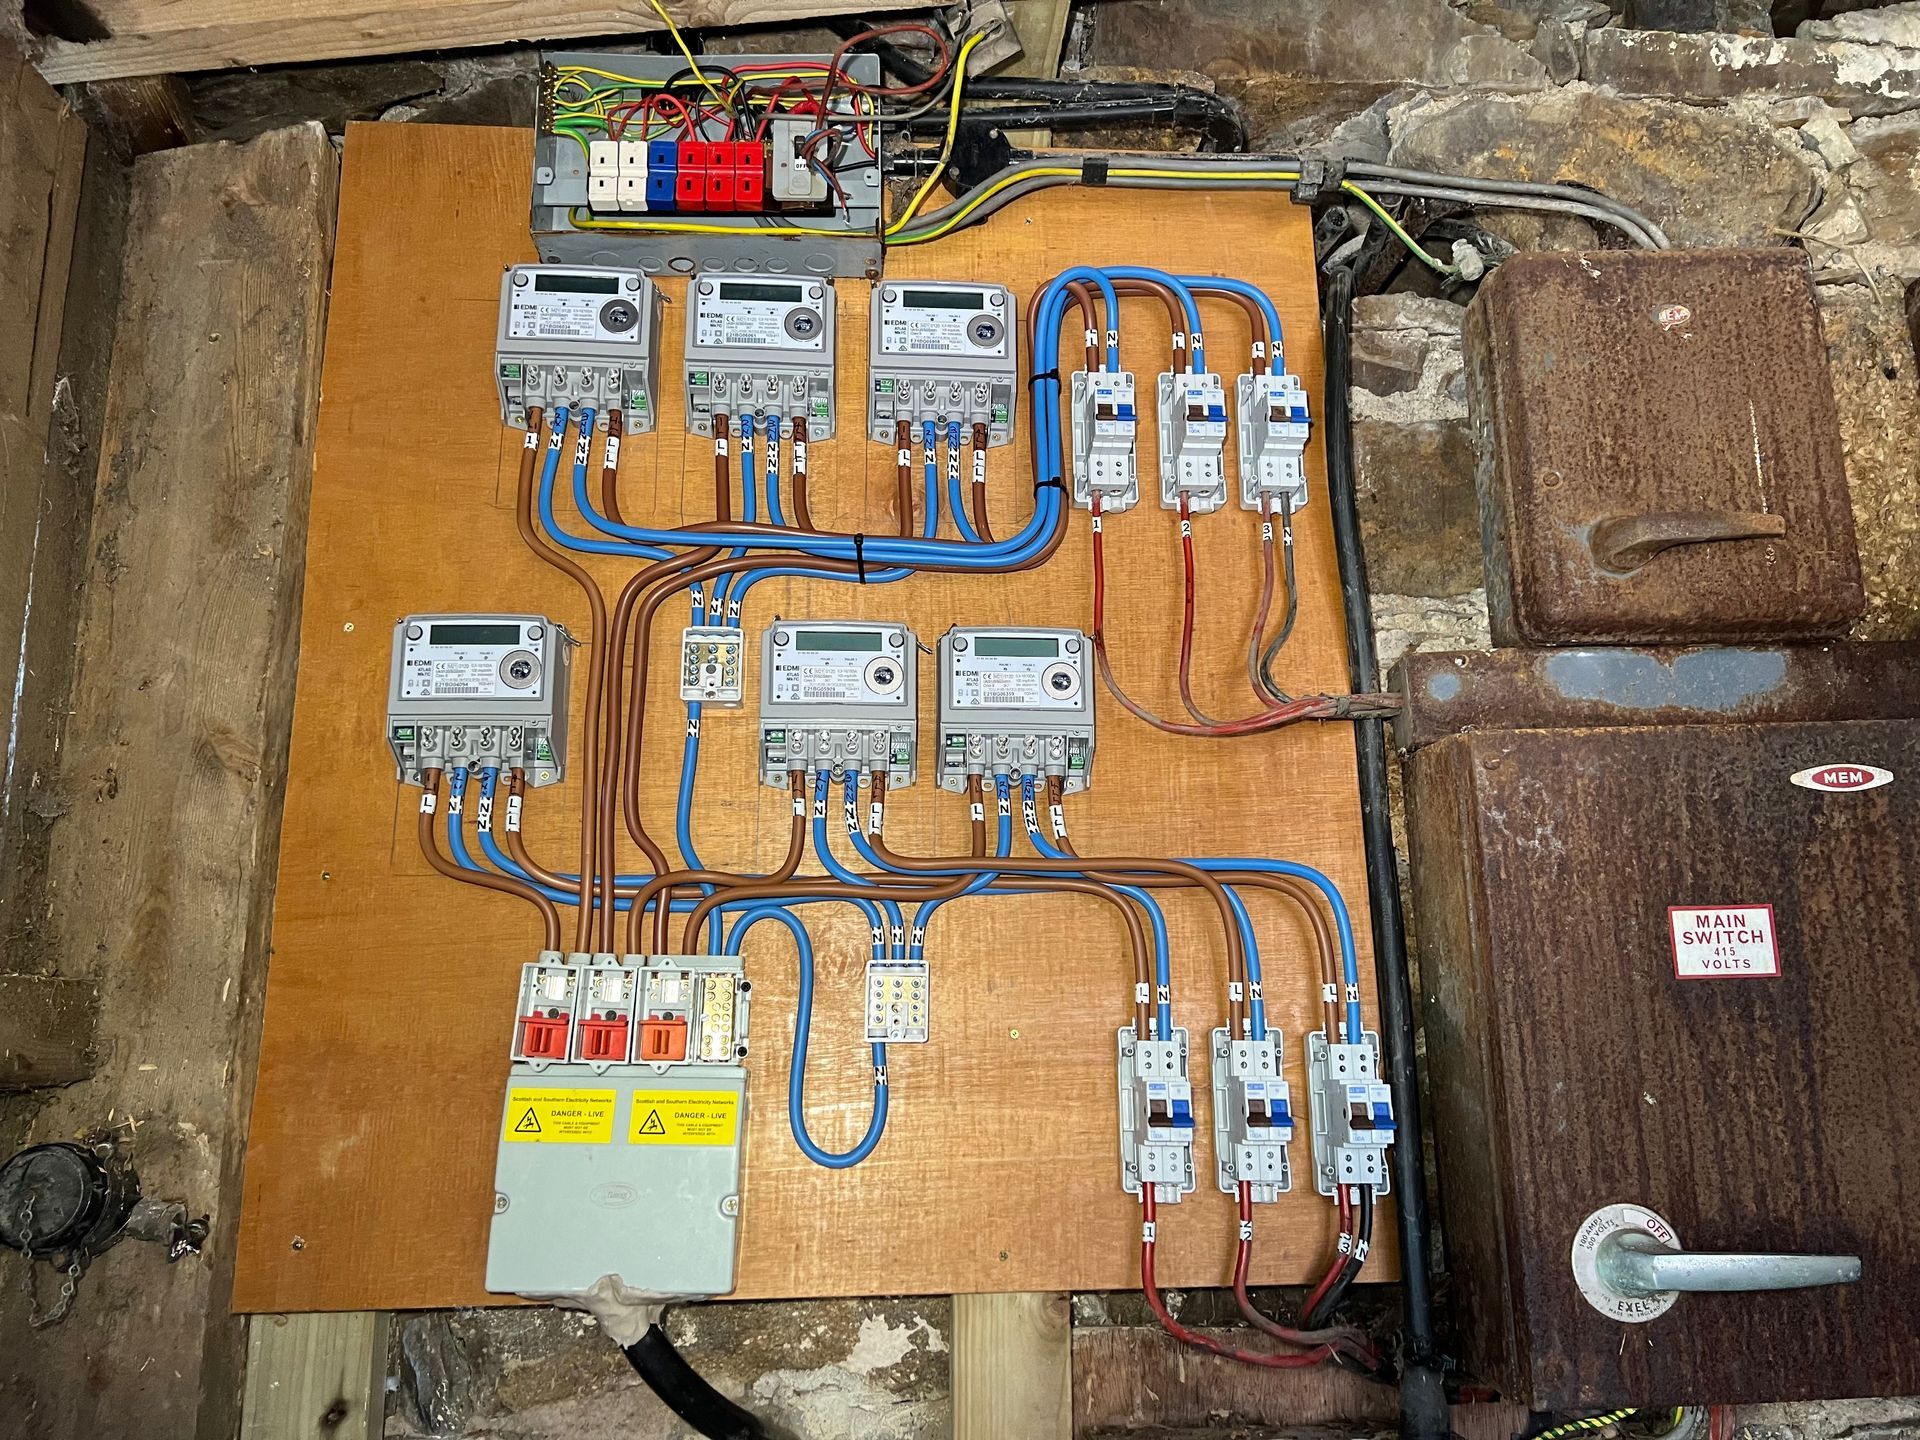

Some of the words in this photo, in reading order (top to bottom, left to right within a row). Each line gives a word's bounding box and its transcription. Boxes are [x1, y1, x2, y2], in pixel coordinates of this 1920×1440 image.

[1193, 335, 1200, 344] N
[1256, 344, 1263, 352] L
[1273, 343, 1280, 351] N
[550, 439, 558, 447] N
[578, 442, 586, 450] N
[608, 439, 615, 447] L
[717, 441, 725, 449] L
[742, 442, 749, 451] N
[768, 443, 776, 452] N
[576, 455, 584, 464] N
[606, 454, 614, 462] L
[904, 451, 910, 460] L
[926, 454, 934, 463] N
[950, 454, 957, 462] N
[976, 452, 983, 460] L
[768, 459, 776, 468] N
[950, 465, 958, 474] N
[976, 468, 983, 476] L
[1094, 520, 1100, 528] 1
[1183, 523, 1190, 532] 2
[1263, 525, 1270, 534] 3
[1284, 529, 1292, 538] N
[693, 597, 702, 606] N
[710, 605, 718, 614] N
[730, 607, 738, 616] N
[689, 720, 697, 729] N
[1823, 771, 1863, 784] MEM
[424, 798, 432, 807] L
[449, 803, 456, 811] N
[510, 799, 518, 808] L
[1025, 802, 1033, 811] N
[481, 803, 489, 812] N
[815, 806, 822, 815] N
[872, 805, 879, 813] L
[975, 805, 982, 814] L
[1001, 804, 1009, 813] N
[1054, 808, 1062, 816] L
[845, 808, 853, 817] N
[478, 820, 486, 829] N
[509, 816, 516, 825] L
[872, 820, 879, 829] L
[1027, 818, 1036, 827] N
[848, 822, 857, 832] N
[1696, 914, 1746, 928] MAIN
[872, 933, 882, 944] N
[893, 932, 902, 943] N
[912, 933, 922, 944] N
[1683, 930, 1764, 945] SWITCH
[1714, 947, 1736, 956] 415
[1701, 959, 1751, 969] VOLTS
[1140, 987, 1148, 997] L
[1234, 985, 1242, 995] L
[1252, 988, 1262, 999] N
[1329, 986, 1337, 995] L
[1159, 991, 1168, 1002] N
[1347, 990, 1357, 1000] N
[875, 1067, 885, 1077] N
[1579, 1235, 1588, 1248] 100
[1586, 1216, 1603, 1236] AMPS
[1646, 1219, 1668, 1241] OFF
[1243, 1231, 1252, 1241] 2
[1586, 1238, 1596, 1251] 500
[1594, 1220, 1615, 1237] VOLTS
[1341, 1242, 1350, 1254] 3
[1618, 1300, 1650, 1313] EXEL
